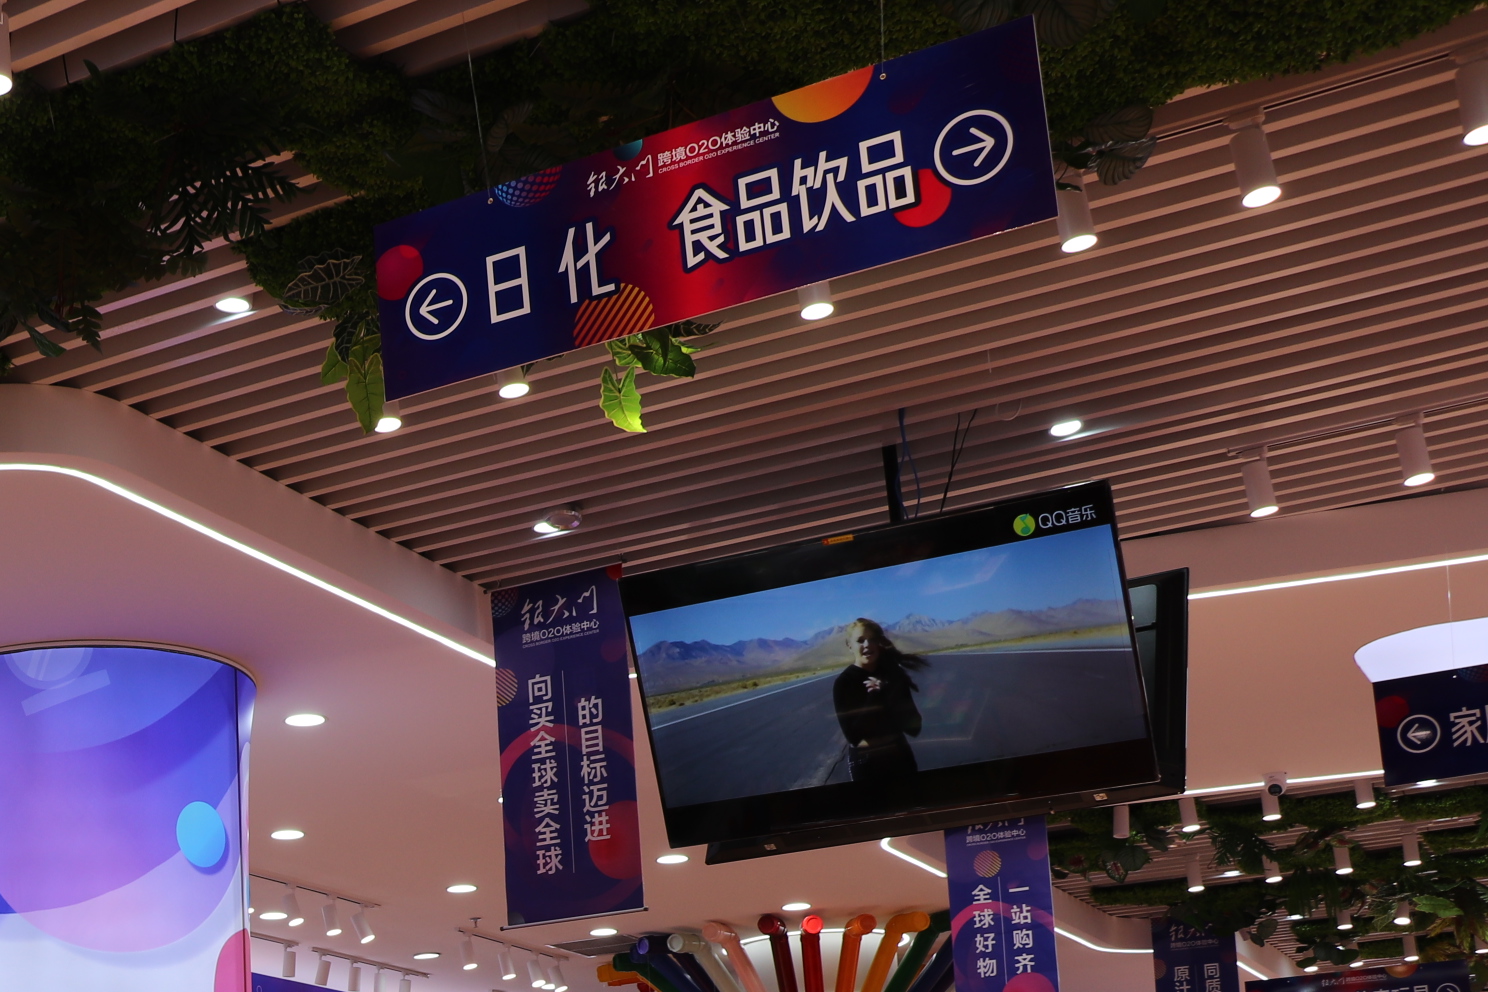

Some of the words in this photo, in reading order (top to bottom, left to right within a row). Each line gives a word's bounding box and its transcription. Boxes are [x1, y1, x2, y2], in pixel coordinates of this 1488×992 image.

[657, 118, 780, 167] 跨境O2O体验中心
[658, 163, 679, 174] CROSS
[679, 156, 704, 170] BORDER
[717, 140, 755, 156] EXPERIENCE
[755, 132, 780, 145] CENTER
[672, 130, 916, 269] 食品饮品
[1038, 503, 1097, 529] QQ音乐
[522, 618, 600, 644] 跨境O2O体验中心
[527, 673, 563, 876] 向买全球卖全球
[578, 695, 612, 844] 的目标迈进
[971, 884, 998, 979] 全球好物
[1008, 886, 1036, 975] 一站购齐
